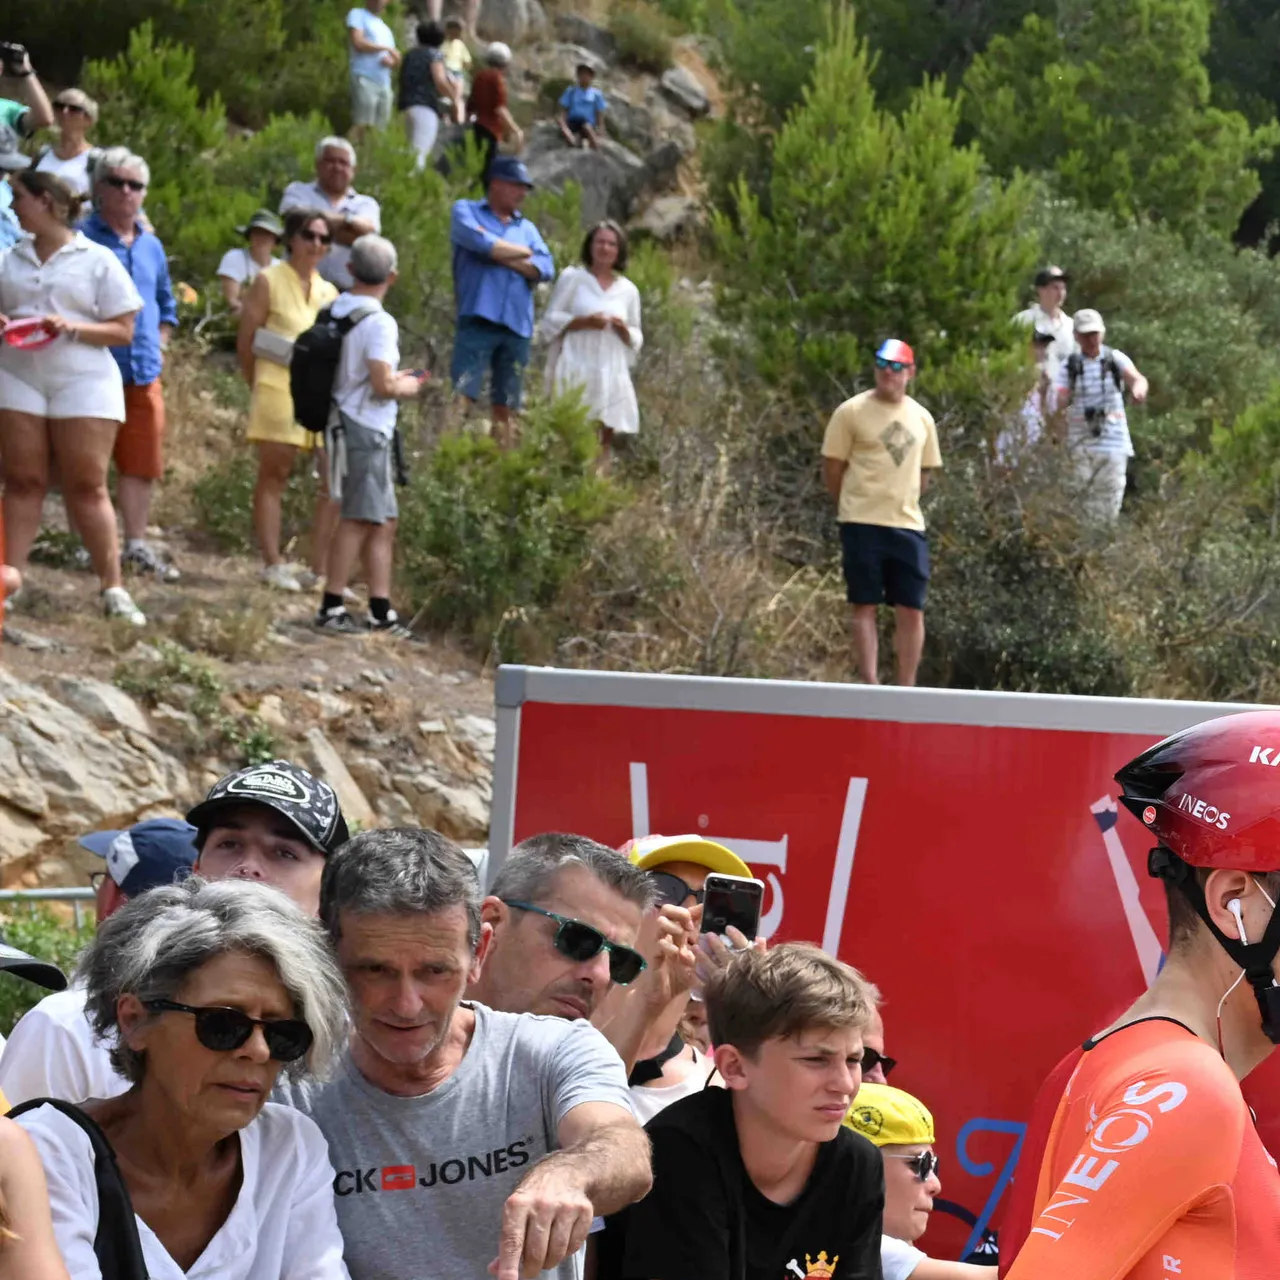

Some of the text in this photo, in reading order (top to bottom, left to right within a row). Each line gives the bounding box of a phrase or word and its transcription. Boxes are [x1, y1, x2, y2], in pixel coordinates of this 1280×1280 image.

[1178, 793, 1231, 830] INEOS
[333, 1141, 529, 1196] CK JONES
[1031, 1080, 1188, 1242] INEOS
